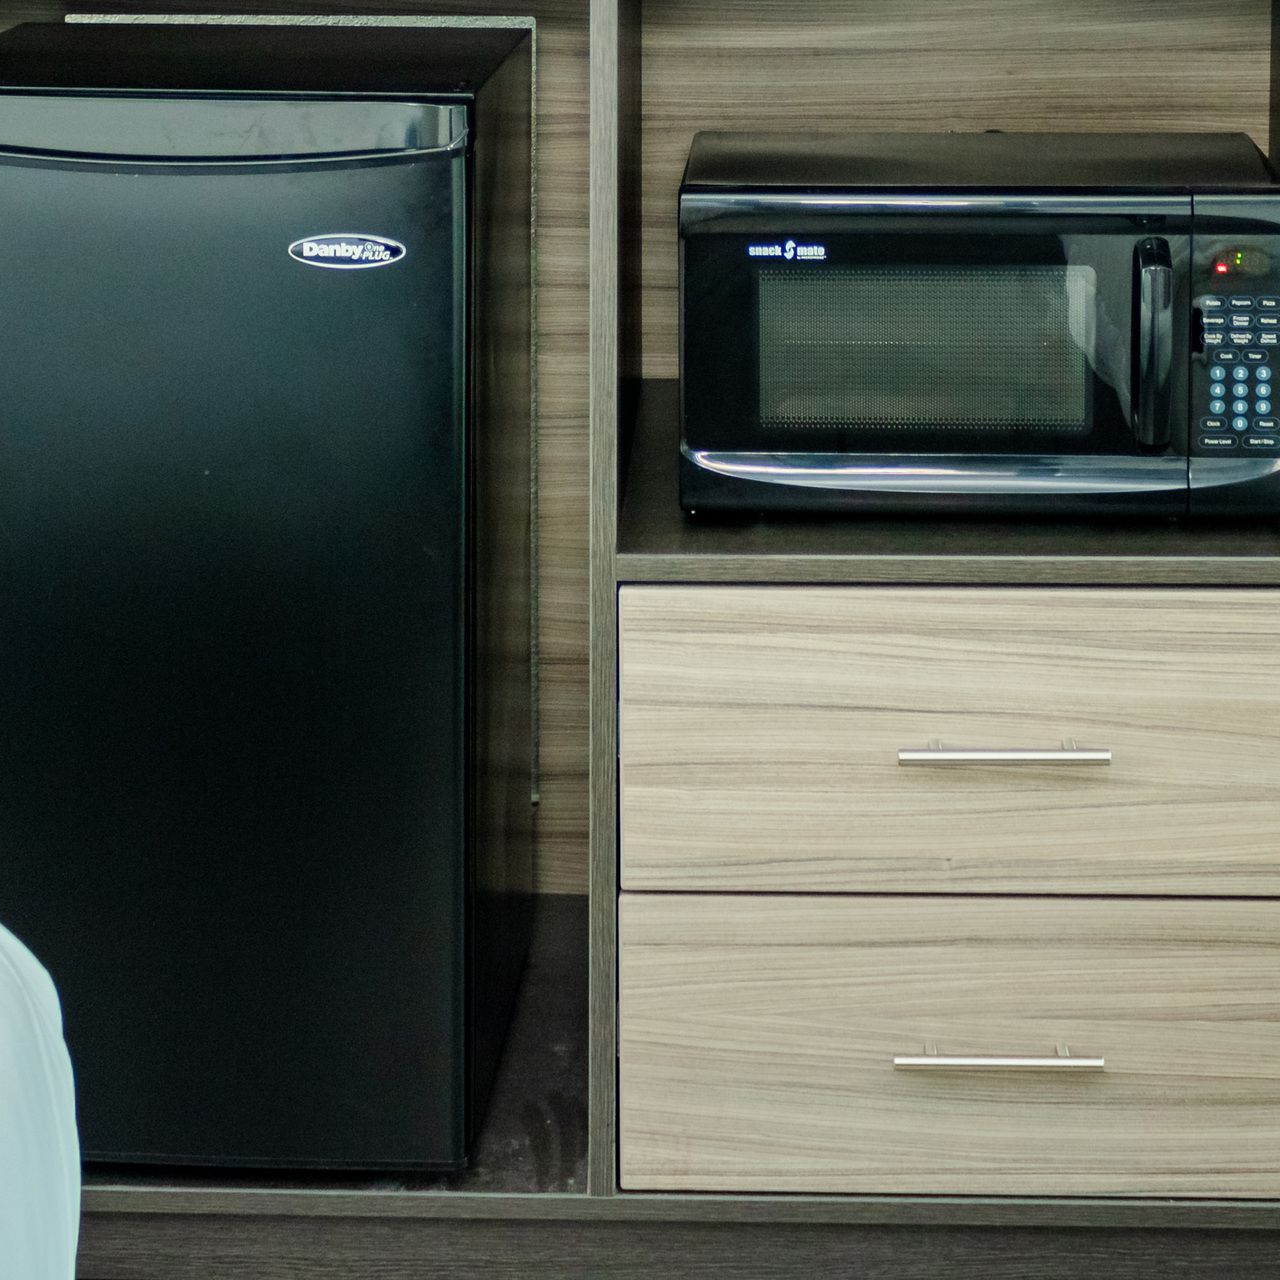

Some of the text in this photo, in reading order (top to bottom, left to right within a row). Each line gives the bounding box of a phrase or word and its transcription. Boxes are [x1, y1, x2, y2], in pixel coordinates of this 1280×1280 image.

[302, 242, 363, 260] Danby
[748, 245, 782, 256] snack
[362, 251, 390, 261] PLUG
[1215, 369, 1220, 377] 1
[1237, 369, 1244, 378] 2
[1260, 369, 1267, 378] 3
[1214, 386, 1221, 394] 4
[1237, 386, 1244, 394] 5
[1260, 386, 1267, 394] 6
[1214, 403, 1221, 411] 7
[1237, 403, 1243, 411] 8
[1260, 403, 1267, 411] 9
[1237, 419, 1243, 428] 0
